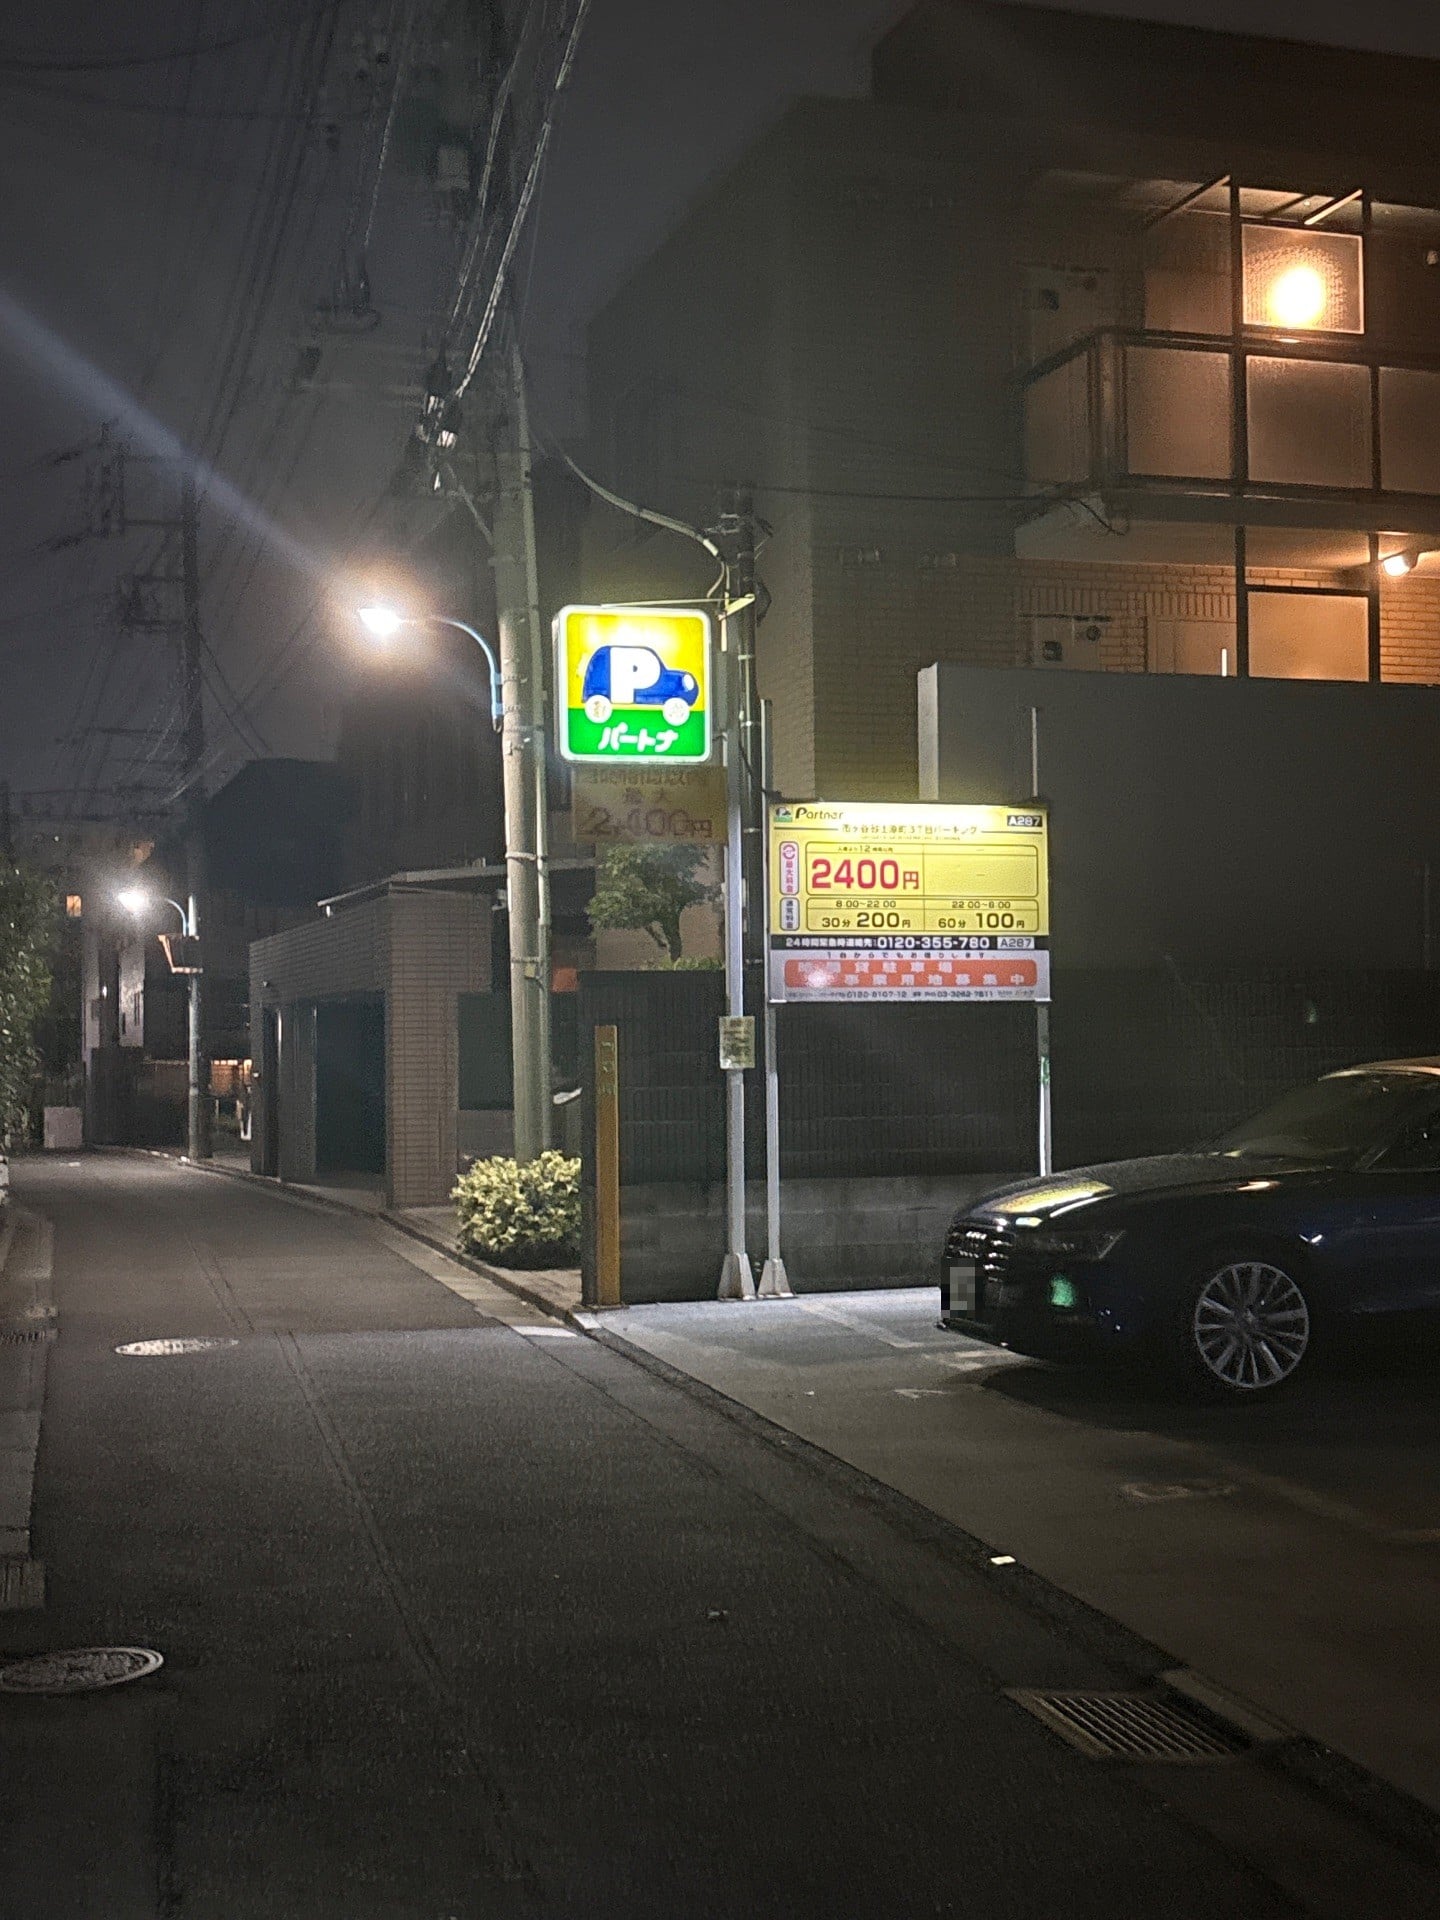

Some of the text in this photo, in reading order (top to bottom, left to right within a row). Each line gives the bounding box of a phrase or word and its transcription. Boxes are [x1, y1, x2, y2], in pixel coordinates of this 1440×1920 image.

[610, 647, 660, 704] P
[795, 807, 844, 819] Partner
[1008, 816, 1041, 826] A287
[812, 859, 919, 890] 2400円
[821, 912, 911, 928] 30分 200円
[938, 912, 1025, 928] 60分 100円
[877, 936, 990, 949] 0120-355-780
[1000, 938, 1032, 948] A287
